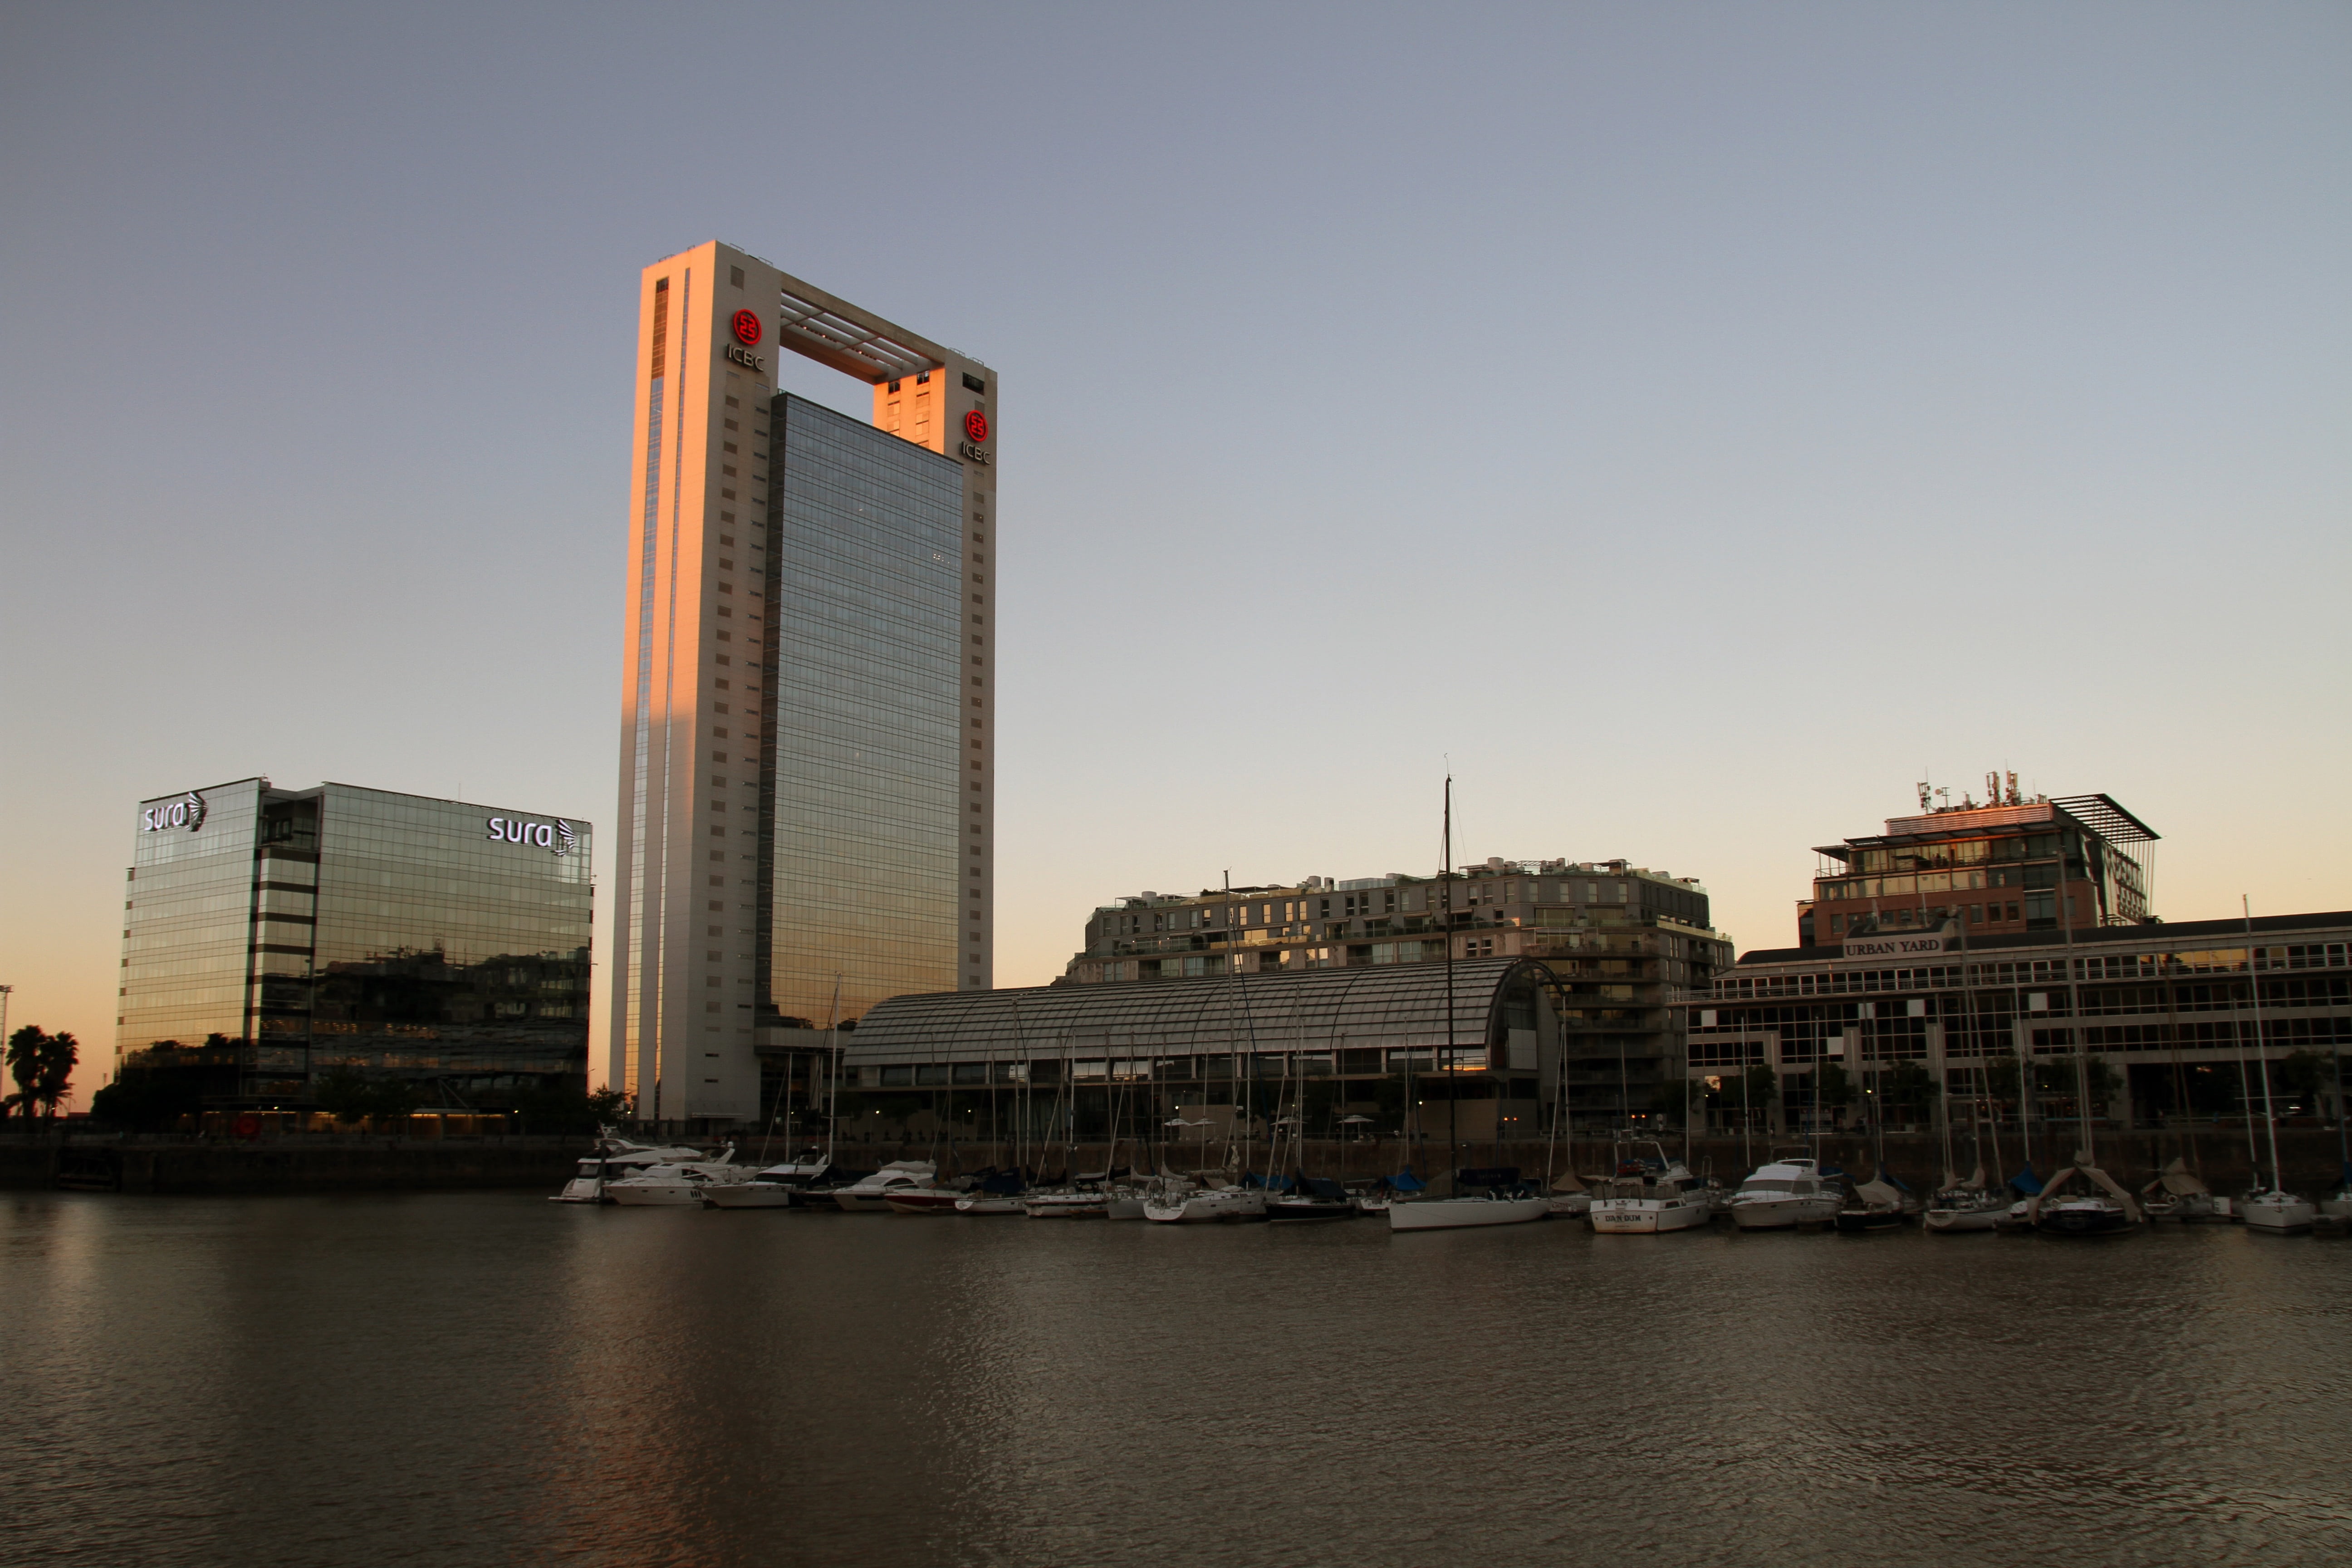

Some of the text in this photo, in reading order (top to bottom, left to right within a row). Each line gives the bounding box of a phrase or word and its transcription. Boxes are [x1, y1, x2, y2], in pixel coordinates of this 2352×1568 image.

[728, 343, 764, 372] ICBC
[962, 441, 990, 465] ICBC
[144, 802, 185, 831] sura
[489, 818, 552, 847] sura
[1845, 939, 1939, 956] URBAN YARD
